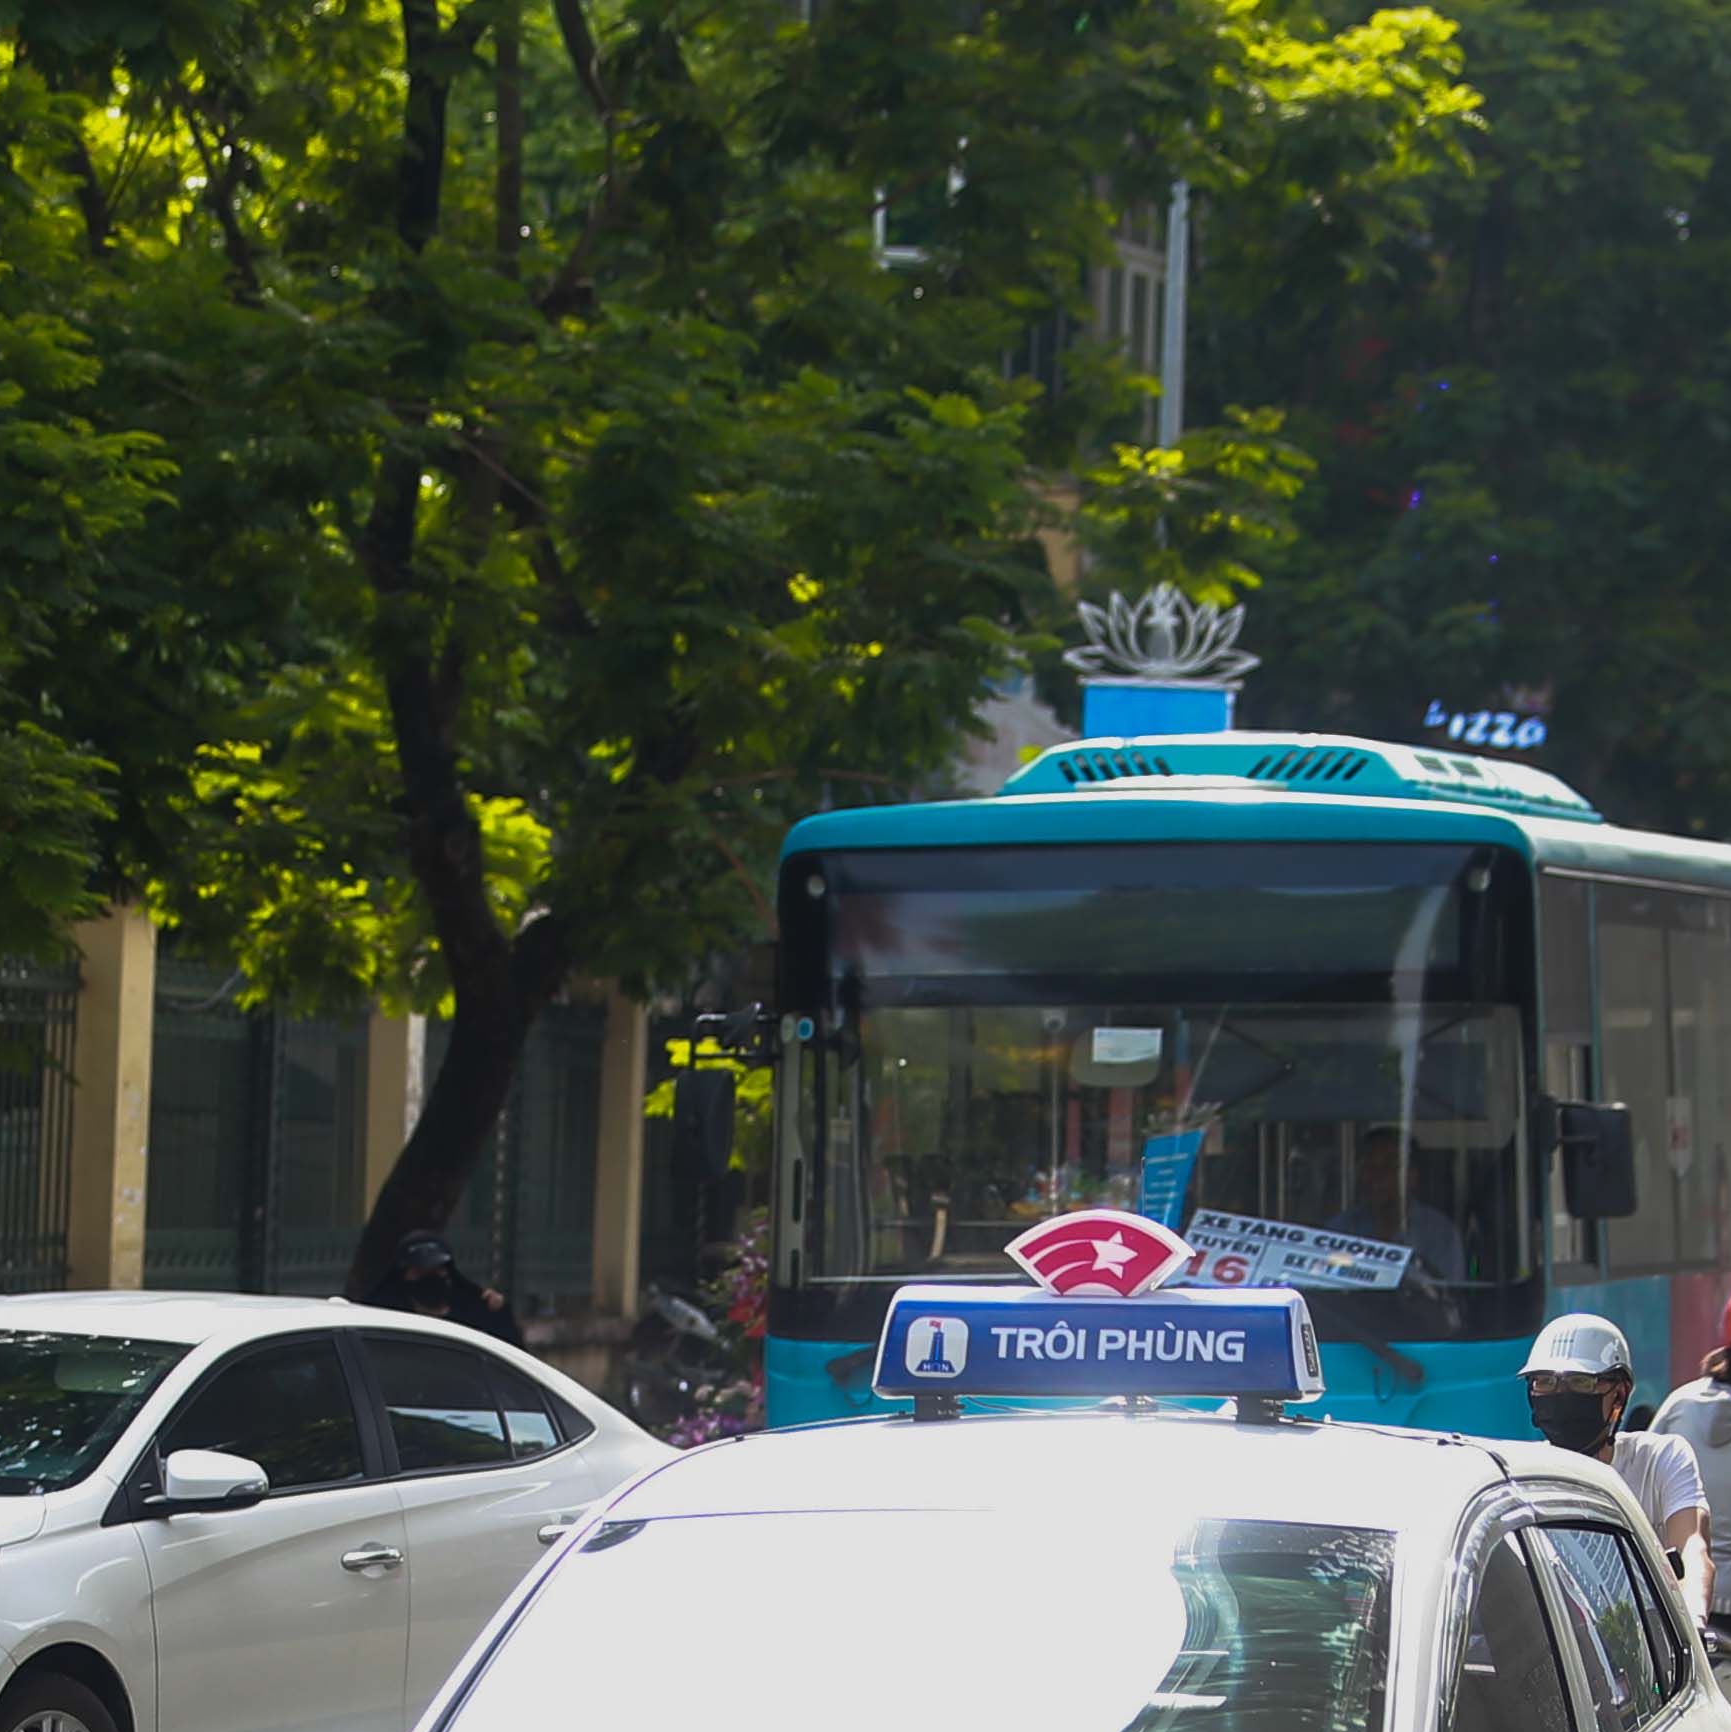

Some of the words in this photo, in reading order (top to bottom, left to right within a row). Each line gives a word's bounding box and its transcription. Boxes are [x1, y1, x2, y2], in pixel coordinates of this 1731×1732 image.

[1199, 1212, 1230, 1229] XE
[1184, 1249, 1250, 1284] 16
[991, 1320, 1085, 1361] TRÔI
[1097, 1321, 1246, 1363] PHÙNG
